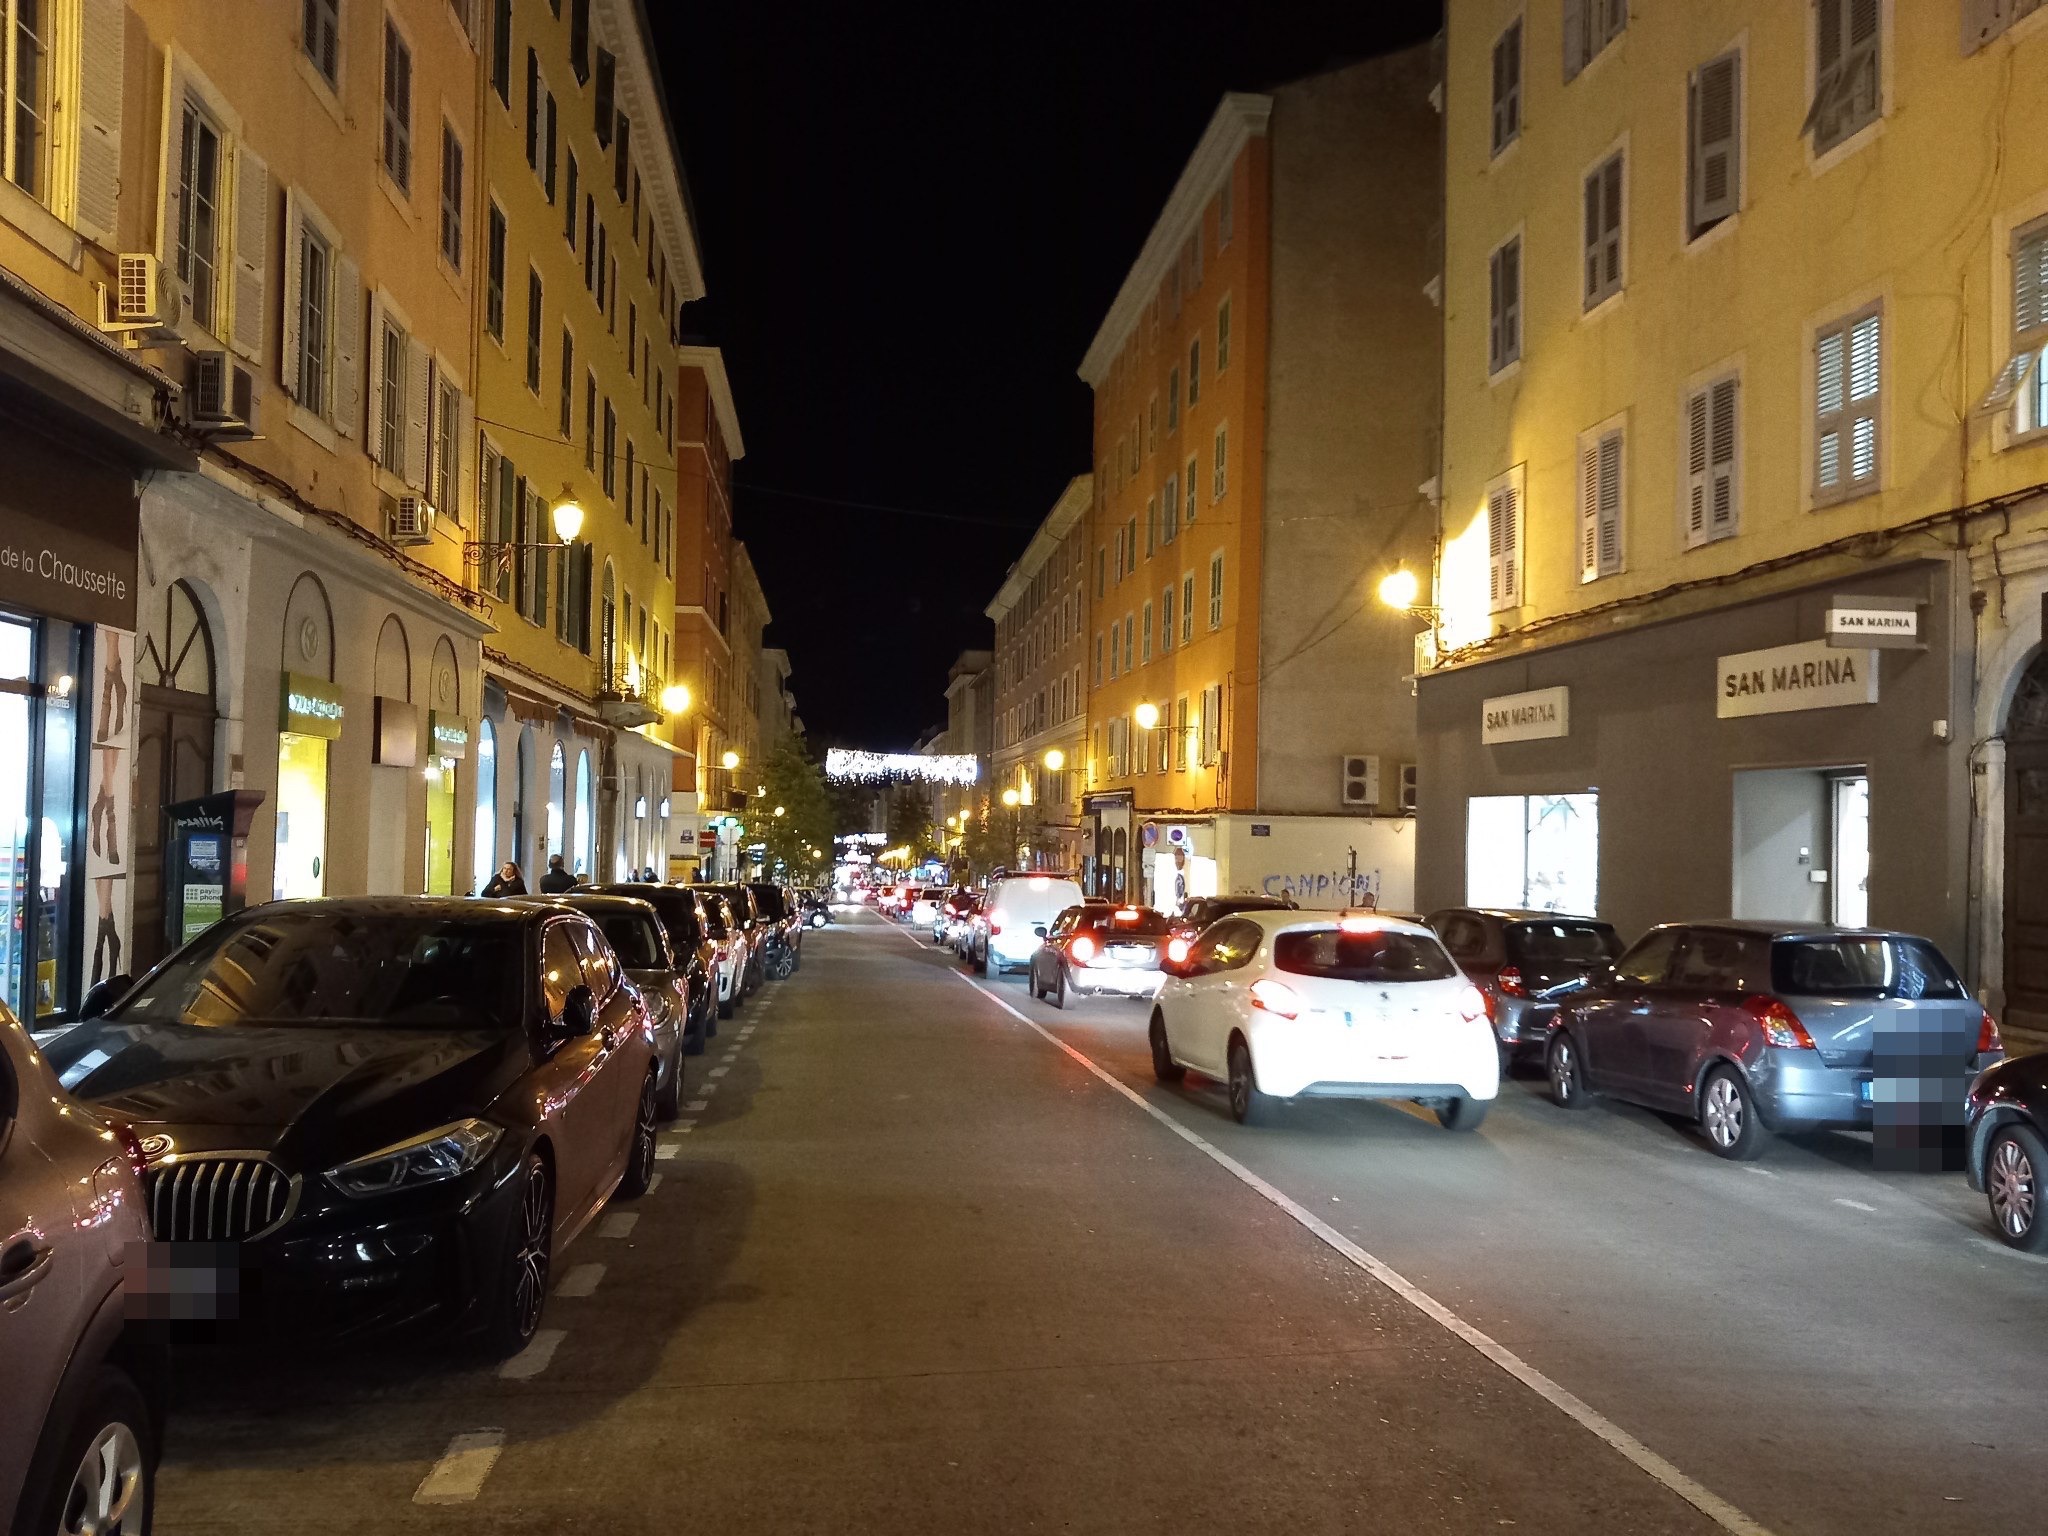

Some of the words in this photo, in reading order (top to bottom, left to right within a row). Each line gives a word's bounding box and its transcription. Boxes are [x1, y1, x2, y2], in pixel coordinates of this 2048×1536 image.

[1, 546, 18, 568] de
[22, 550, 33, 572] la
[39, 549, 125, 600] Chaussette
[1840, 616, 1864, 626] SAN
[1867, 617, 1910, 627] MARINA
[1725, 670, 1765, 698] SAN
[1772, 656, 1856, 692] MARINA
[1487, 710, 1508, 730] SAN
[1511, 704, 1555, 725] MARINA
